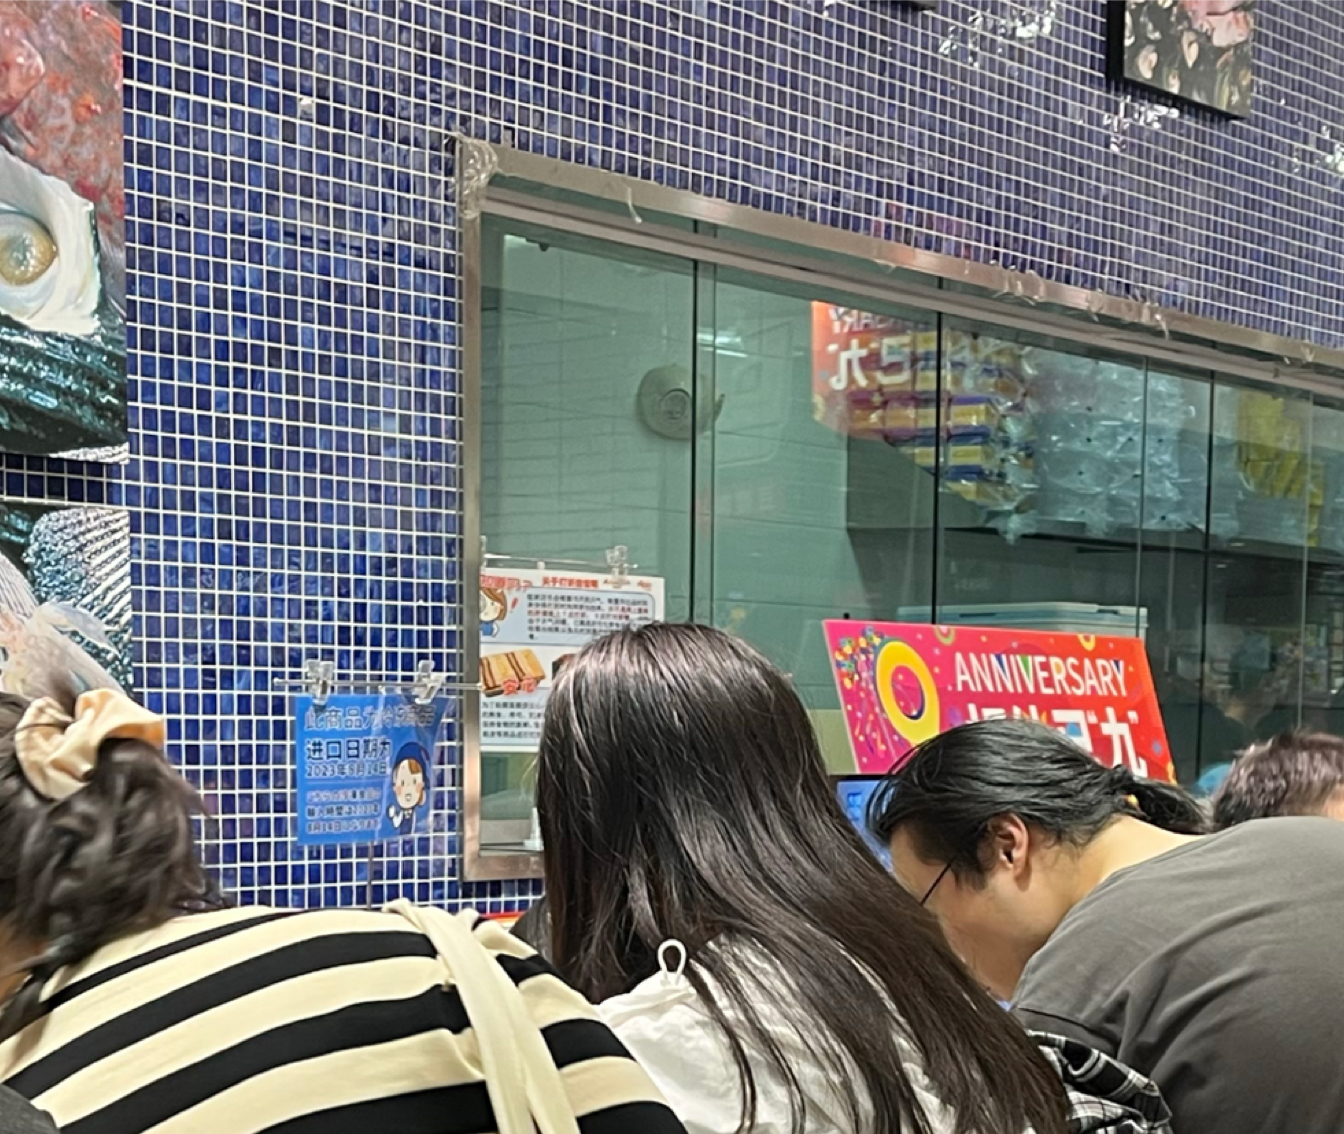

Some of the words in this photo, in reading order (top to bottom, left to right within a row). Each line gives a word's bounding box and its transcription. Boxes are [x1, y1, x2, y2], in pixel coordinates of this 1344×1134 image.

[954, 651, 1128, 698] ANNIVERSARY
[306, 738, 391, 760] 进口日期为
